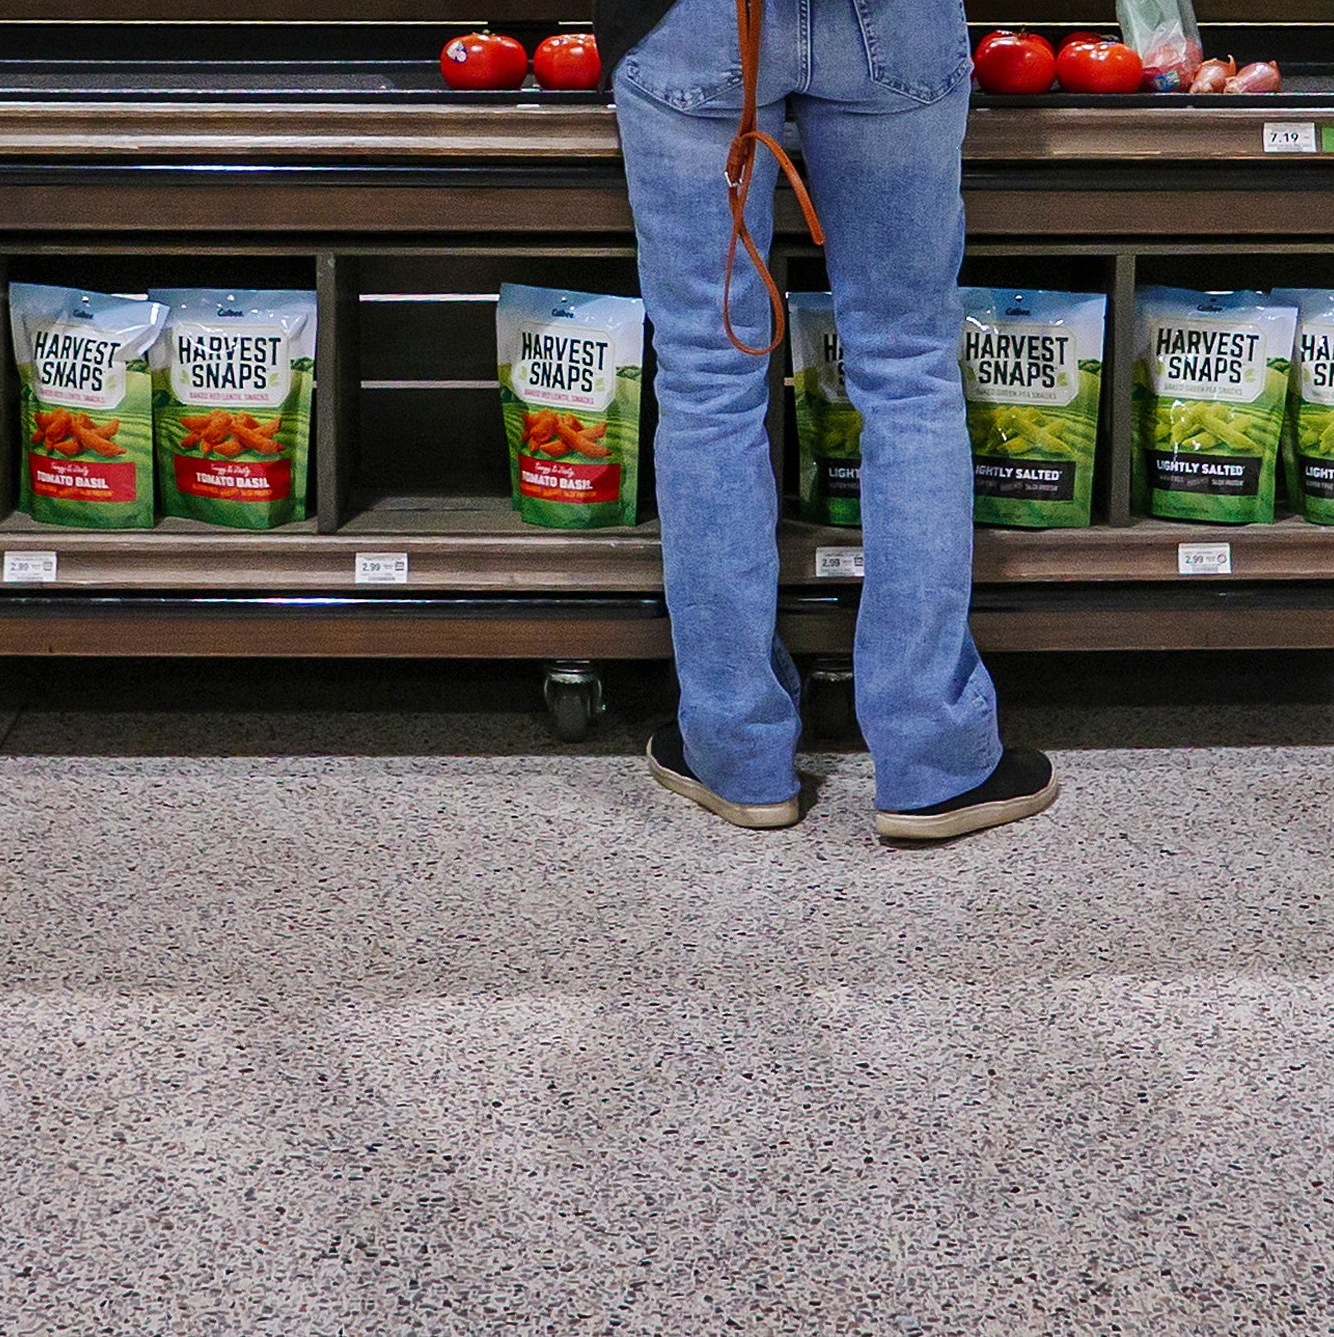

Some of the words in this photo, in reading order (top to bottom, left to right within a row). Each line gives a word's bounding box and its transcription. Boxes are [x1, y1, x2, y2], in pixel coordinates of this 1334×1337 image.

[1270, 132, 1299, 143] 7.19
[35, 331, 121, 368] HARVEST
[178, 335, 281, 365] HARVEST
[521, 332, 608, 370] HARVEST
[966, 332, 1068, 364] HARVEST
[1156, 328, 1259, 362] HARVEST
[42, 361, 104, 391] SNAPS
[192, 364, 267, 389] SNAPS
[529, 361, 593, 392] SNAPS
[978, 360, 1055, 388] SNAPS
[1168, 357, 1242, 383] SNAPS
[37, 471, 72, 486] TOMATO
[76, 476, 109, 489] BASIL
[196, 472, 234, 487] TOMATO
[236, 475, 269, 488] BASIL
[522, 471, 557, 488] TOMATO
[976, 467, 1013, 478] IGHTLY
[1016, 468, 1060, 481] SALTED
[1157, 460, 1198, 474] LIGHTLY
[1202, 463, 1244, 476] SALTED
